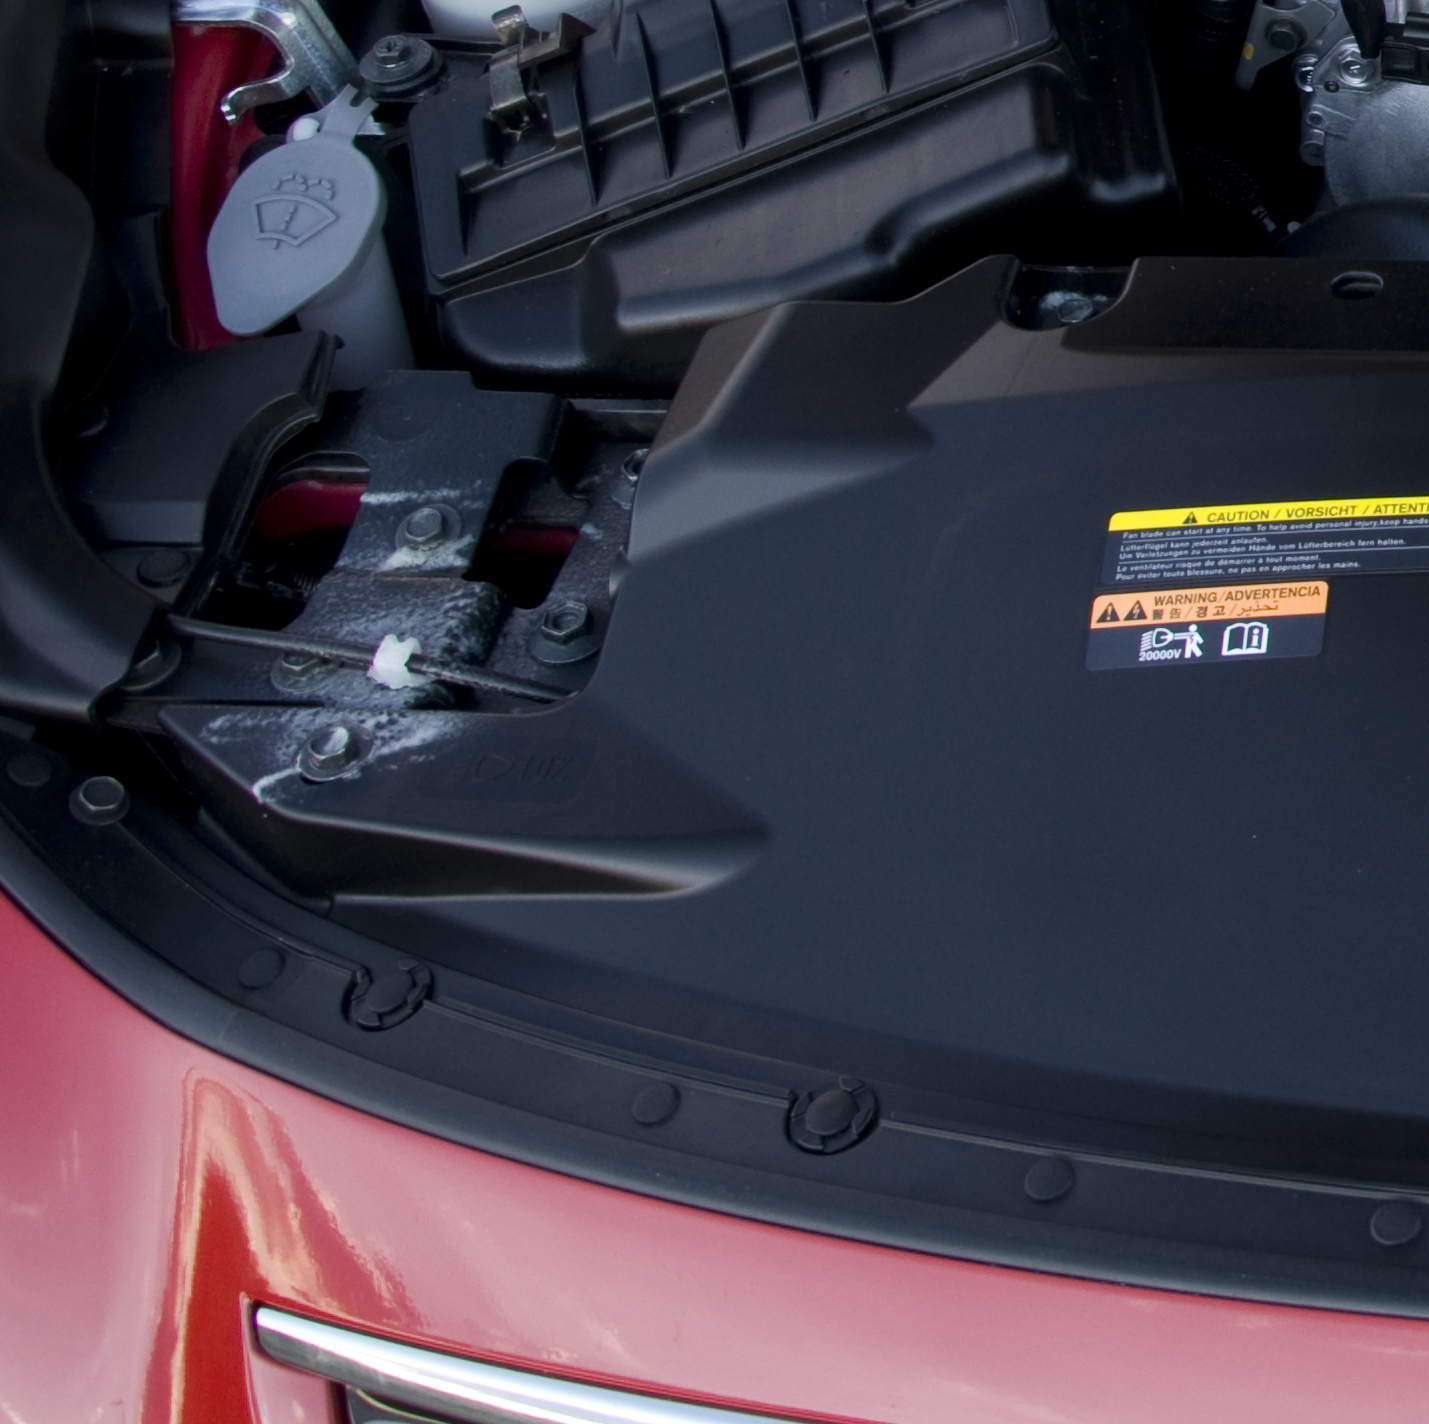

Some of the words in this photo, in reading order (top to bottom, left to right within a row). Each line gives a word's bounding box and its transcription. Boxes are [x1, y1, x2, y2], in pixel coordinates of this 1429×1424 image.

[1207, 509, 1269, 523] CAUTION
[1286, 505, 1357, 519] VORSICHT
[1123, 531, 1138, 539] Fan
[1216, 527, 1230, 535] any
[1290, 522, 1312, 530] avoid
[1315, 520, 1352, 530] personal
[1116, 573, 1135, 581] Pour
[1241, 566, 1256, 575] pas
[1272, 562, 1315, 572] approcher
[1318, 561, 1331, 569] les
[1333, 560, 1361, 568] mains.
[1204, 559, 1215, 567] de
[1139, 649, 1181, 661] 20000V
